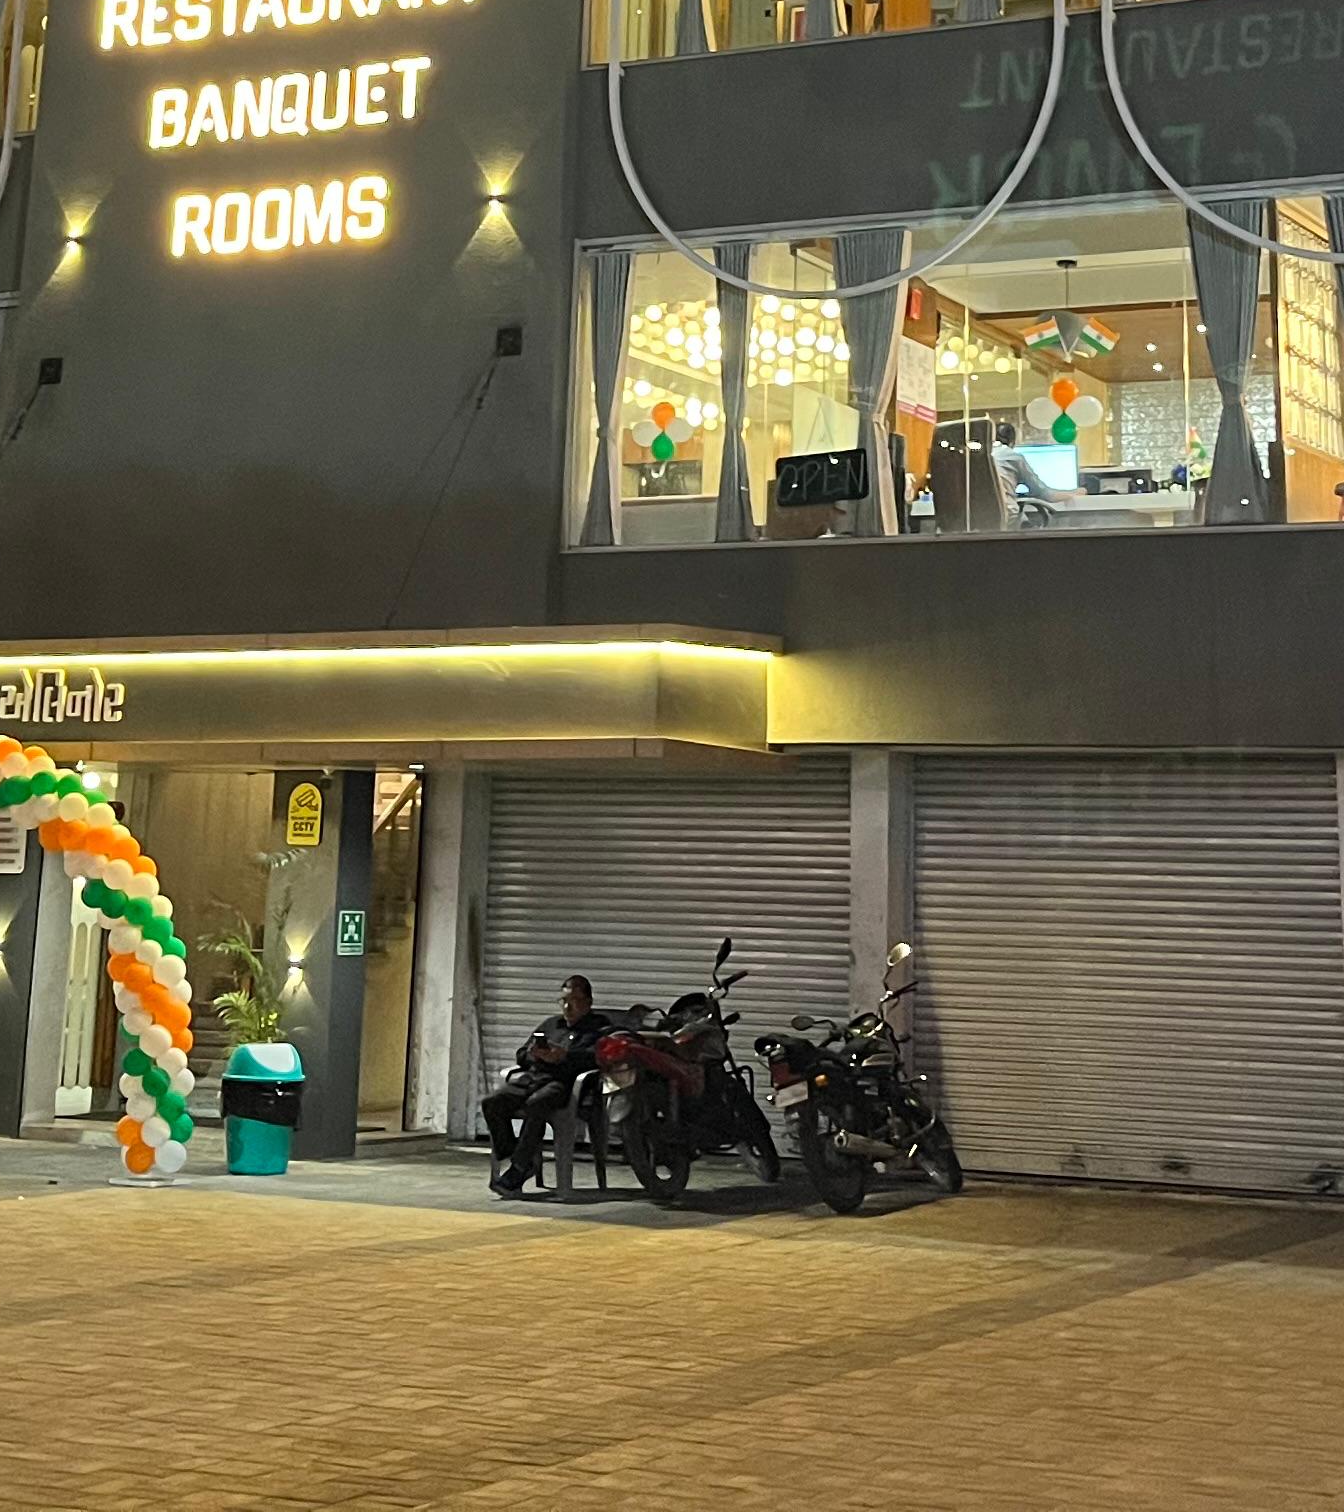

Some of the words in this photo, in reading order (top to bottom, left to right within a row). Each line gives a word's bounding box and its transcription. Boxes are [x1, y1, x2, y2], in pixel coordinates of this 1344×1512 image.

[148, 56, 431, 150] BANQUET
[171, 176, 389, 258] ROOMS
[777, 453, 865, 501] OPEN
